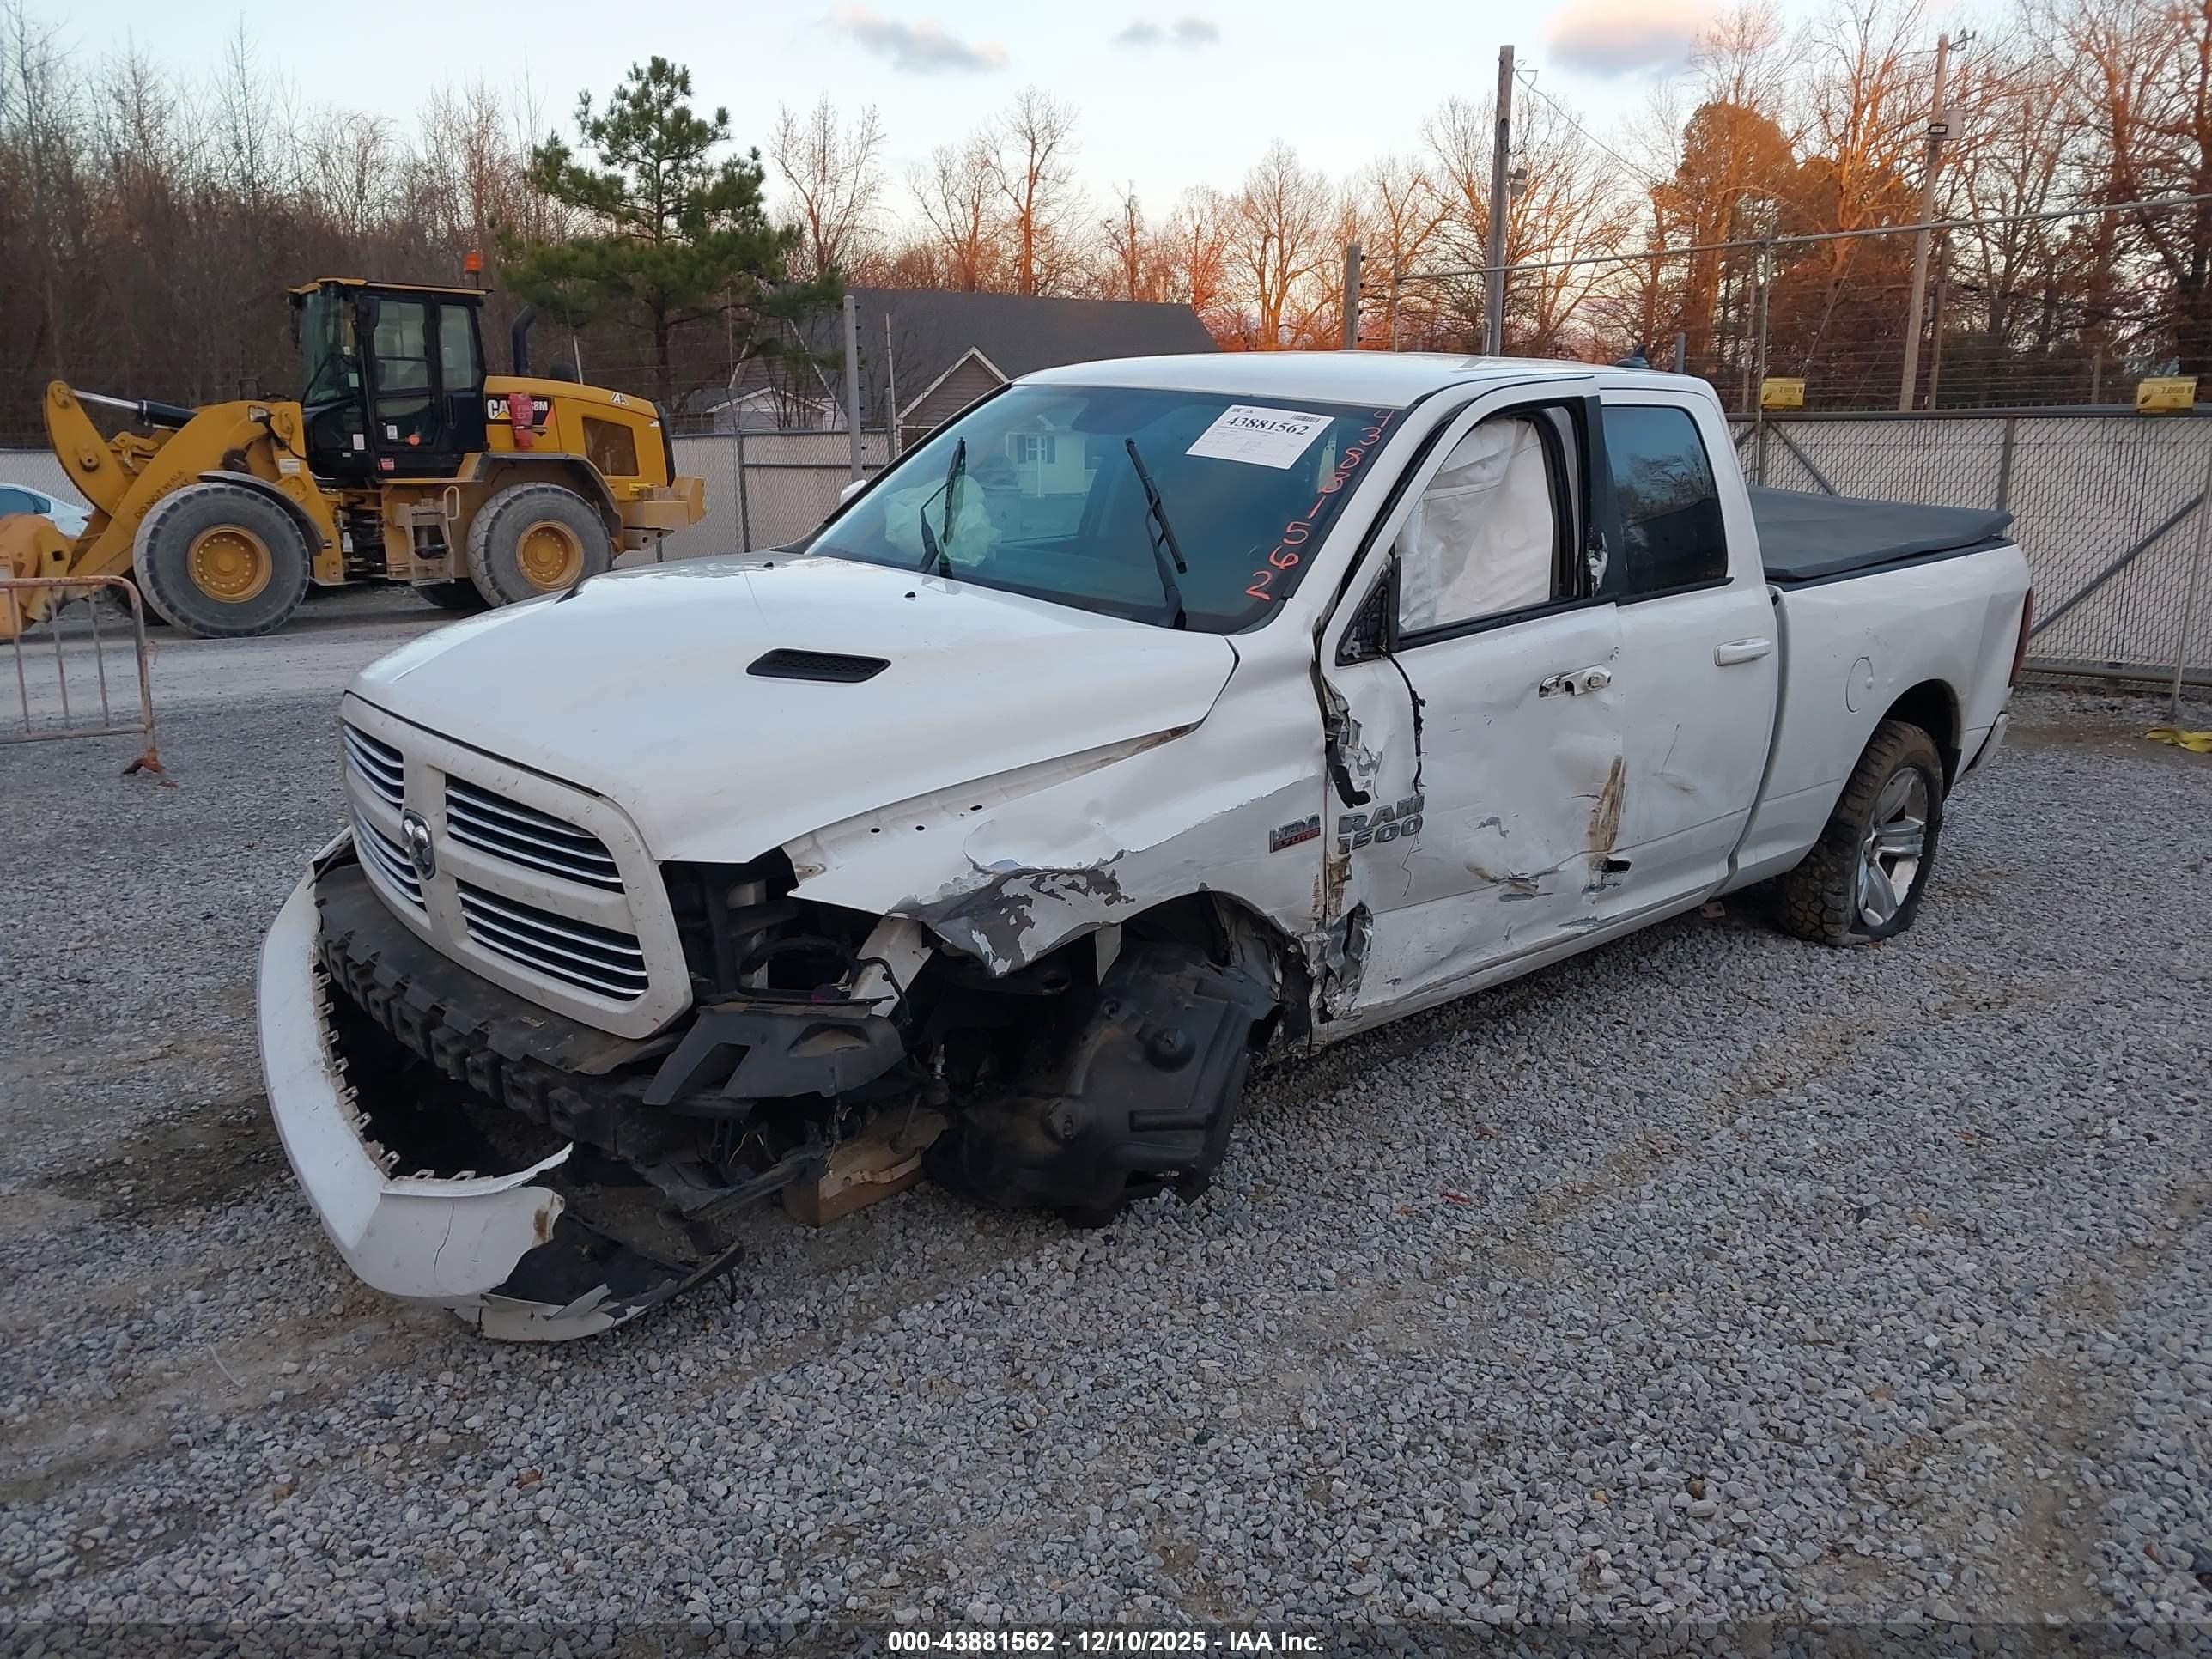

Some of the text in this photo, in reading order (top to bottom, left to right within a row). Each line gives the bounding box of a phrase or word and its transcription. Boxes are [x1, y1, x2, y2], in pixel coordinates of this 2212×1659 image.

[2160, 386, 2185, 395] 7,000
[487, 399, 511, 420] CA
[1225, 416, 1310, 435] 43881562
[134, 506, 148, 520] DO
[146, 489, 163, 507] NOT
[1270, 813, 1321, 842] HEMI
[1338, 794, 1425, 834] RAM
[1337, 814, 1424, 854] 1500
